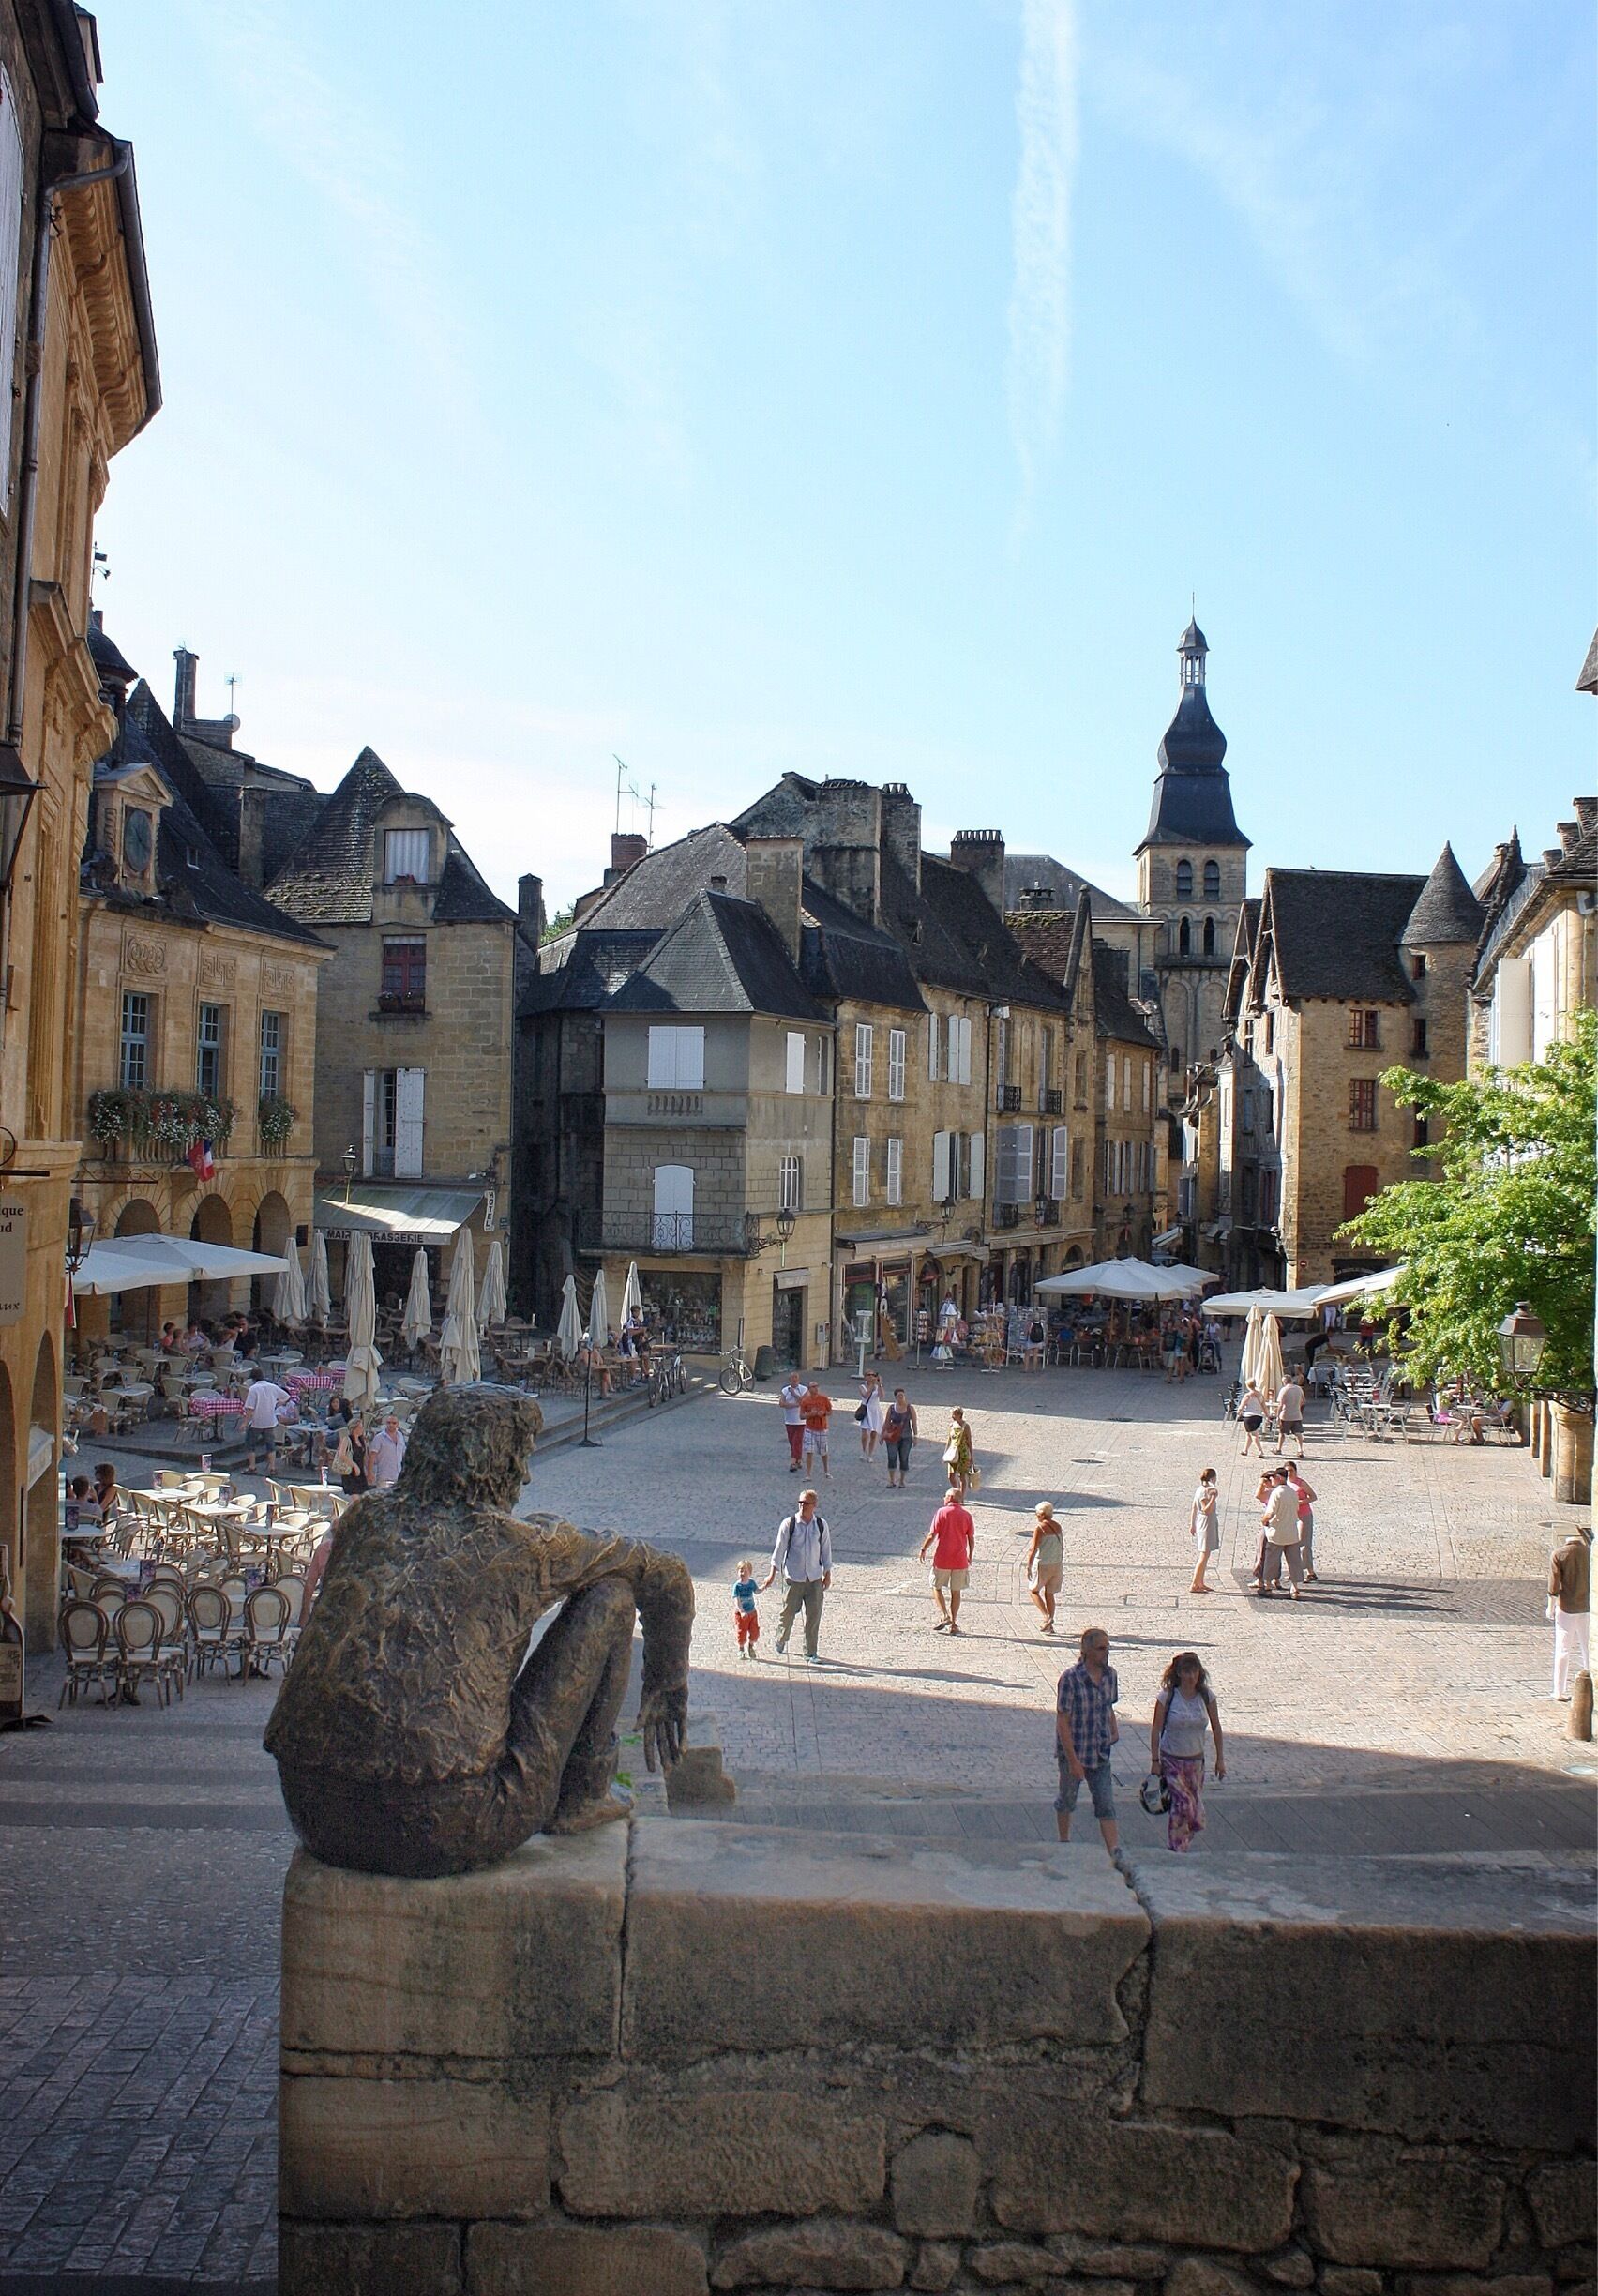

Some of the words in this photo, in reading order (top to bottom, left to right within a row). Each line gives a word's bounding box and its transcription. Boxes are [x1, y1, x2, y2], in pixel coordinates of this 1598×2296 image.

[0, 1207, 24, 1218] que
[486, 1191, 494, 1227] HOTEL
[367, 1231, 424, 1243] BRASSERIE
[0, 1302, 20, 1311] ux
